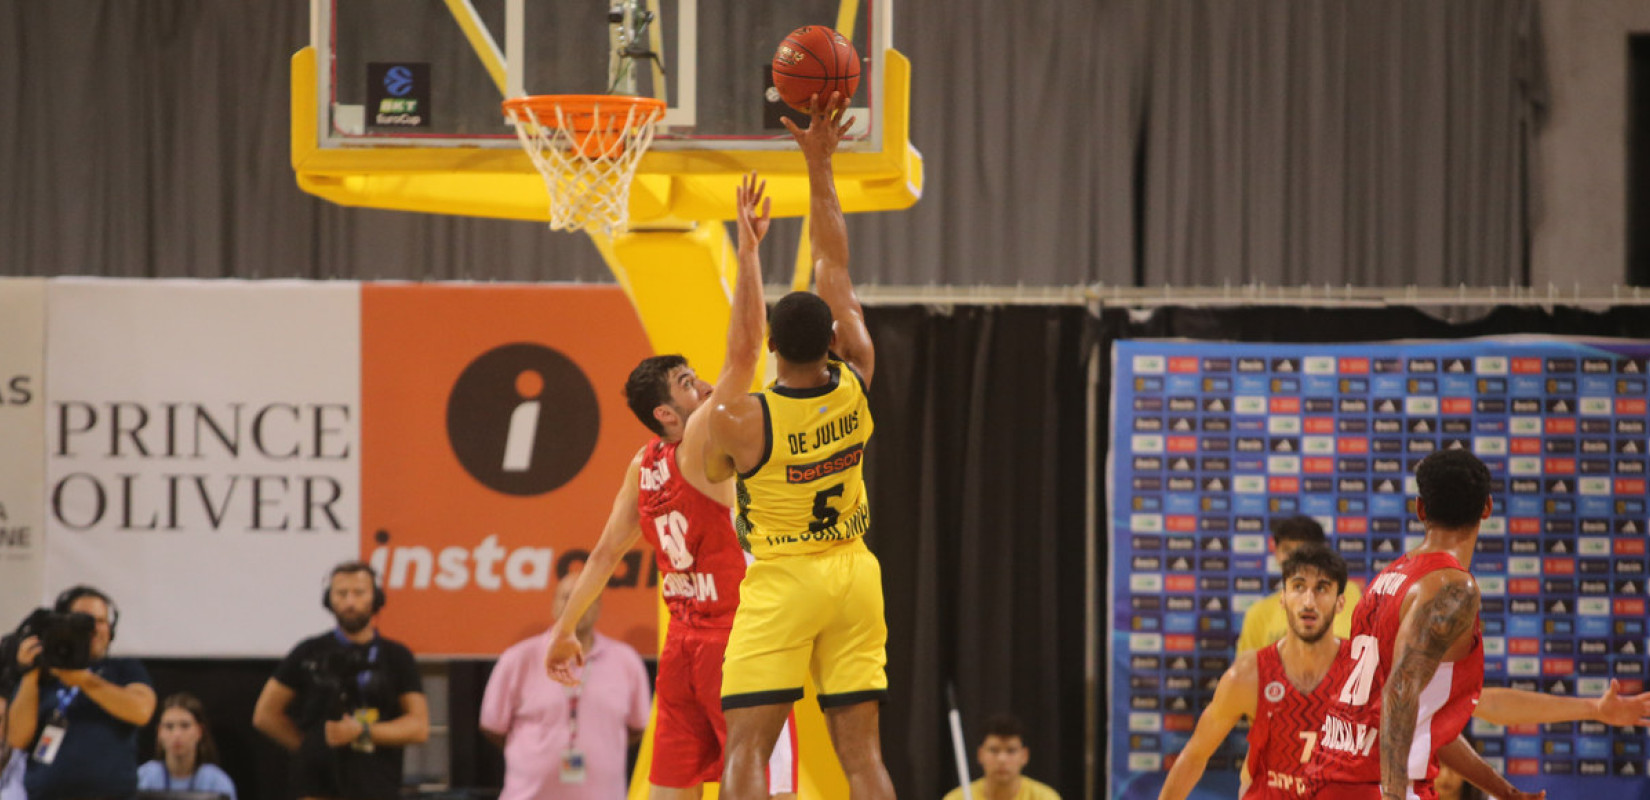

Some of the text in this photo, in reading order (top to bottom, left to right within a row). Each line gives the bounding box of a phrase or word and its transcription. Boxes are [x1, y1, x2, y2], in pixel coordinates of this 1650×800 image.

[53, 401, 350, 460] PRINCE
[788, 410, 859, 456] DE JULIUS
[788, 448, 864, 482] betsson
[51, 471, 347, 533] OLIVER
[808, 482, 845, 534] 5
[1299, 731, 1318, 764] 7
